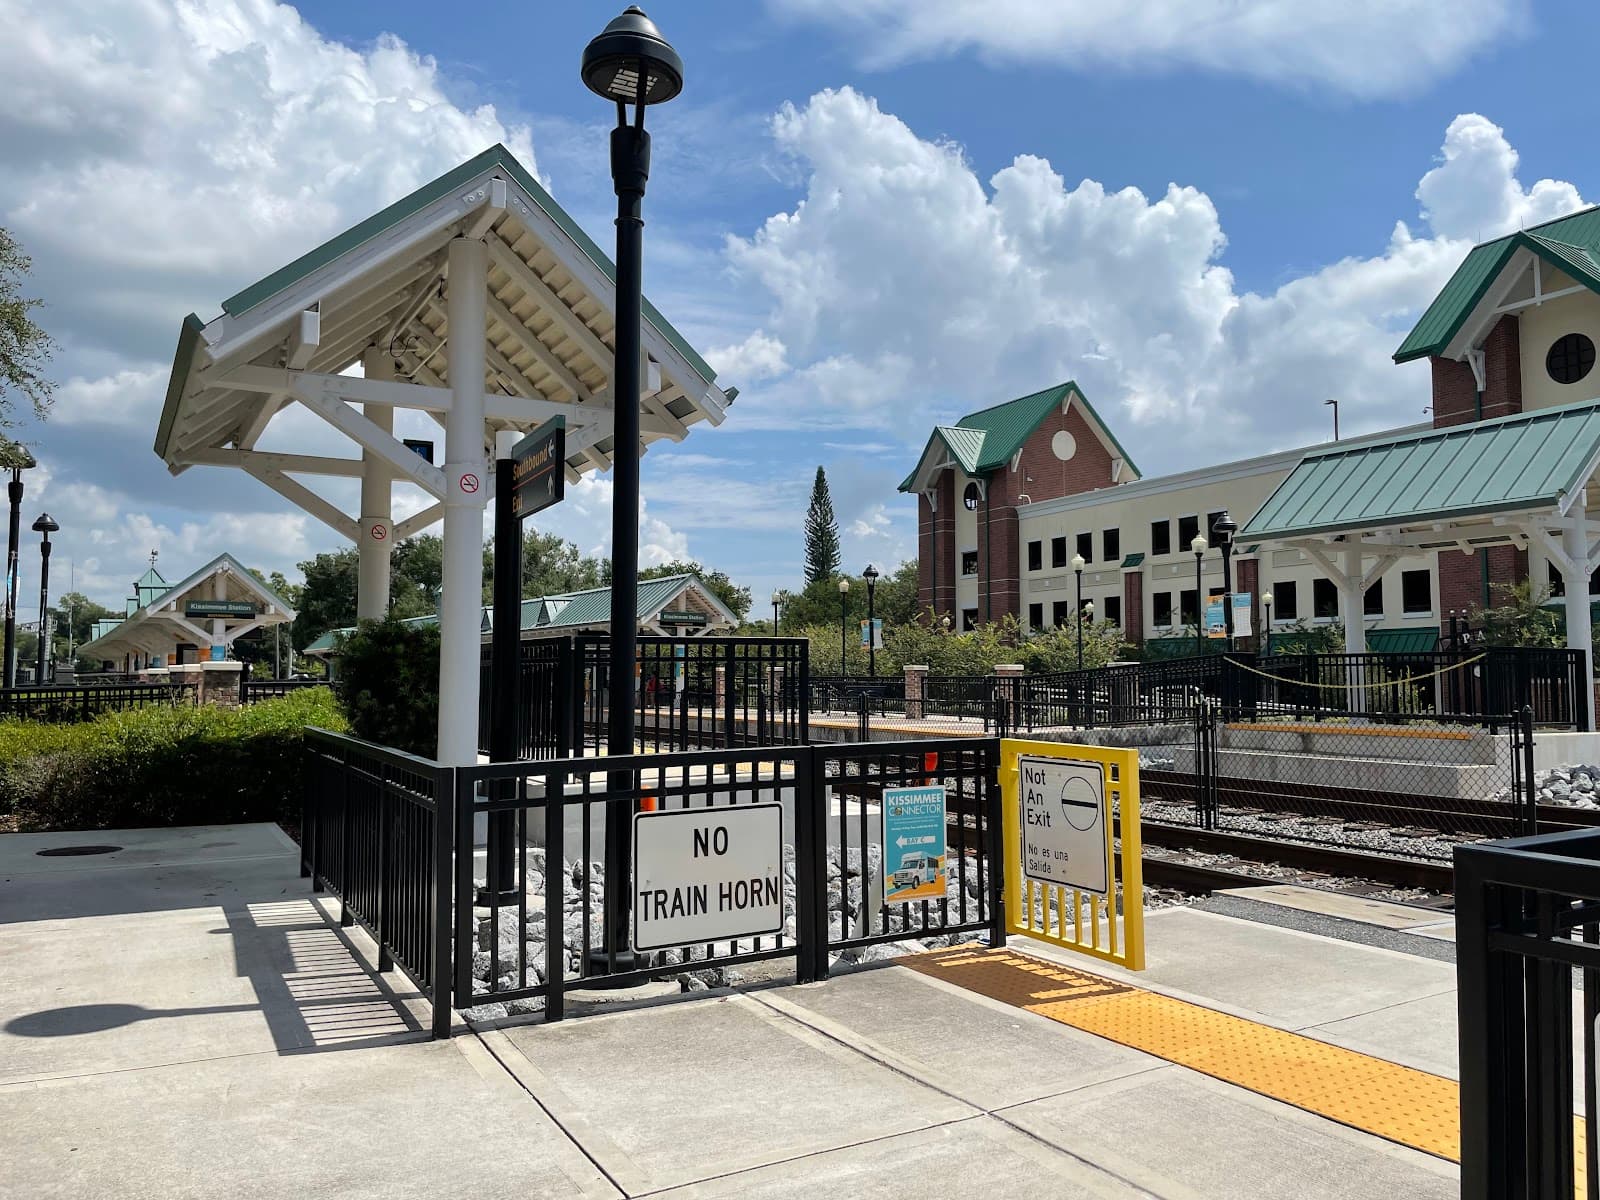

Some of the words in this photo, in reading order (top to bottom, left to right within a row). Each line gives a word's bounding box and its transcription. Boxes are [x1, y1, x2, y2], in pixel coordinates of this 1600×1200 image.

[513, 444, 548, 480] Southbound
[190, 603, 227, 611] Kissimmee
[1025, 767, 1046, 786] Not
[888, 793, 942, 806] KISSIMMEE
[1027, 788, 1044, 806] An
[888, 804, 942, 817] CONNECTOR
[1027, 808, 1052, 828] Exit
[693, 826, 729, 858] NO
[1028, 842, 1038, 855] No
[1054, 850, 1069, 861] una
[1029, 858, 1052, 874] Salida
[639, 884, 708, 922] TRAIN
[719, 876, 779, 912] HORN
